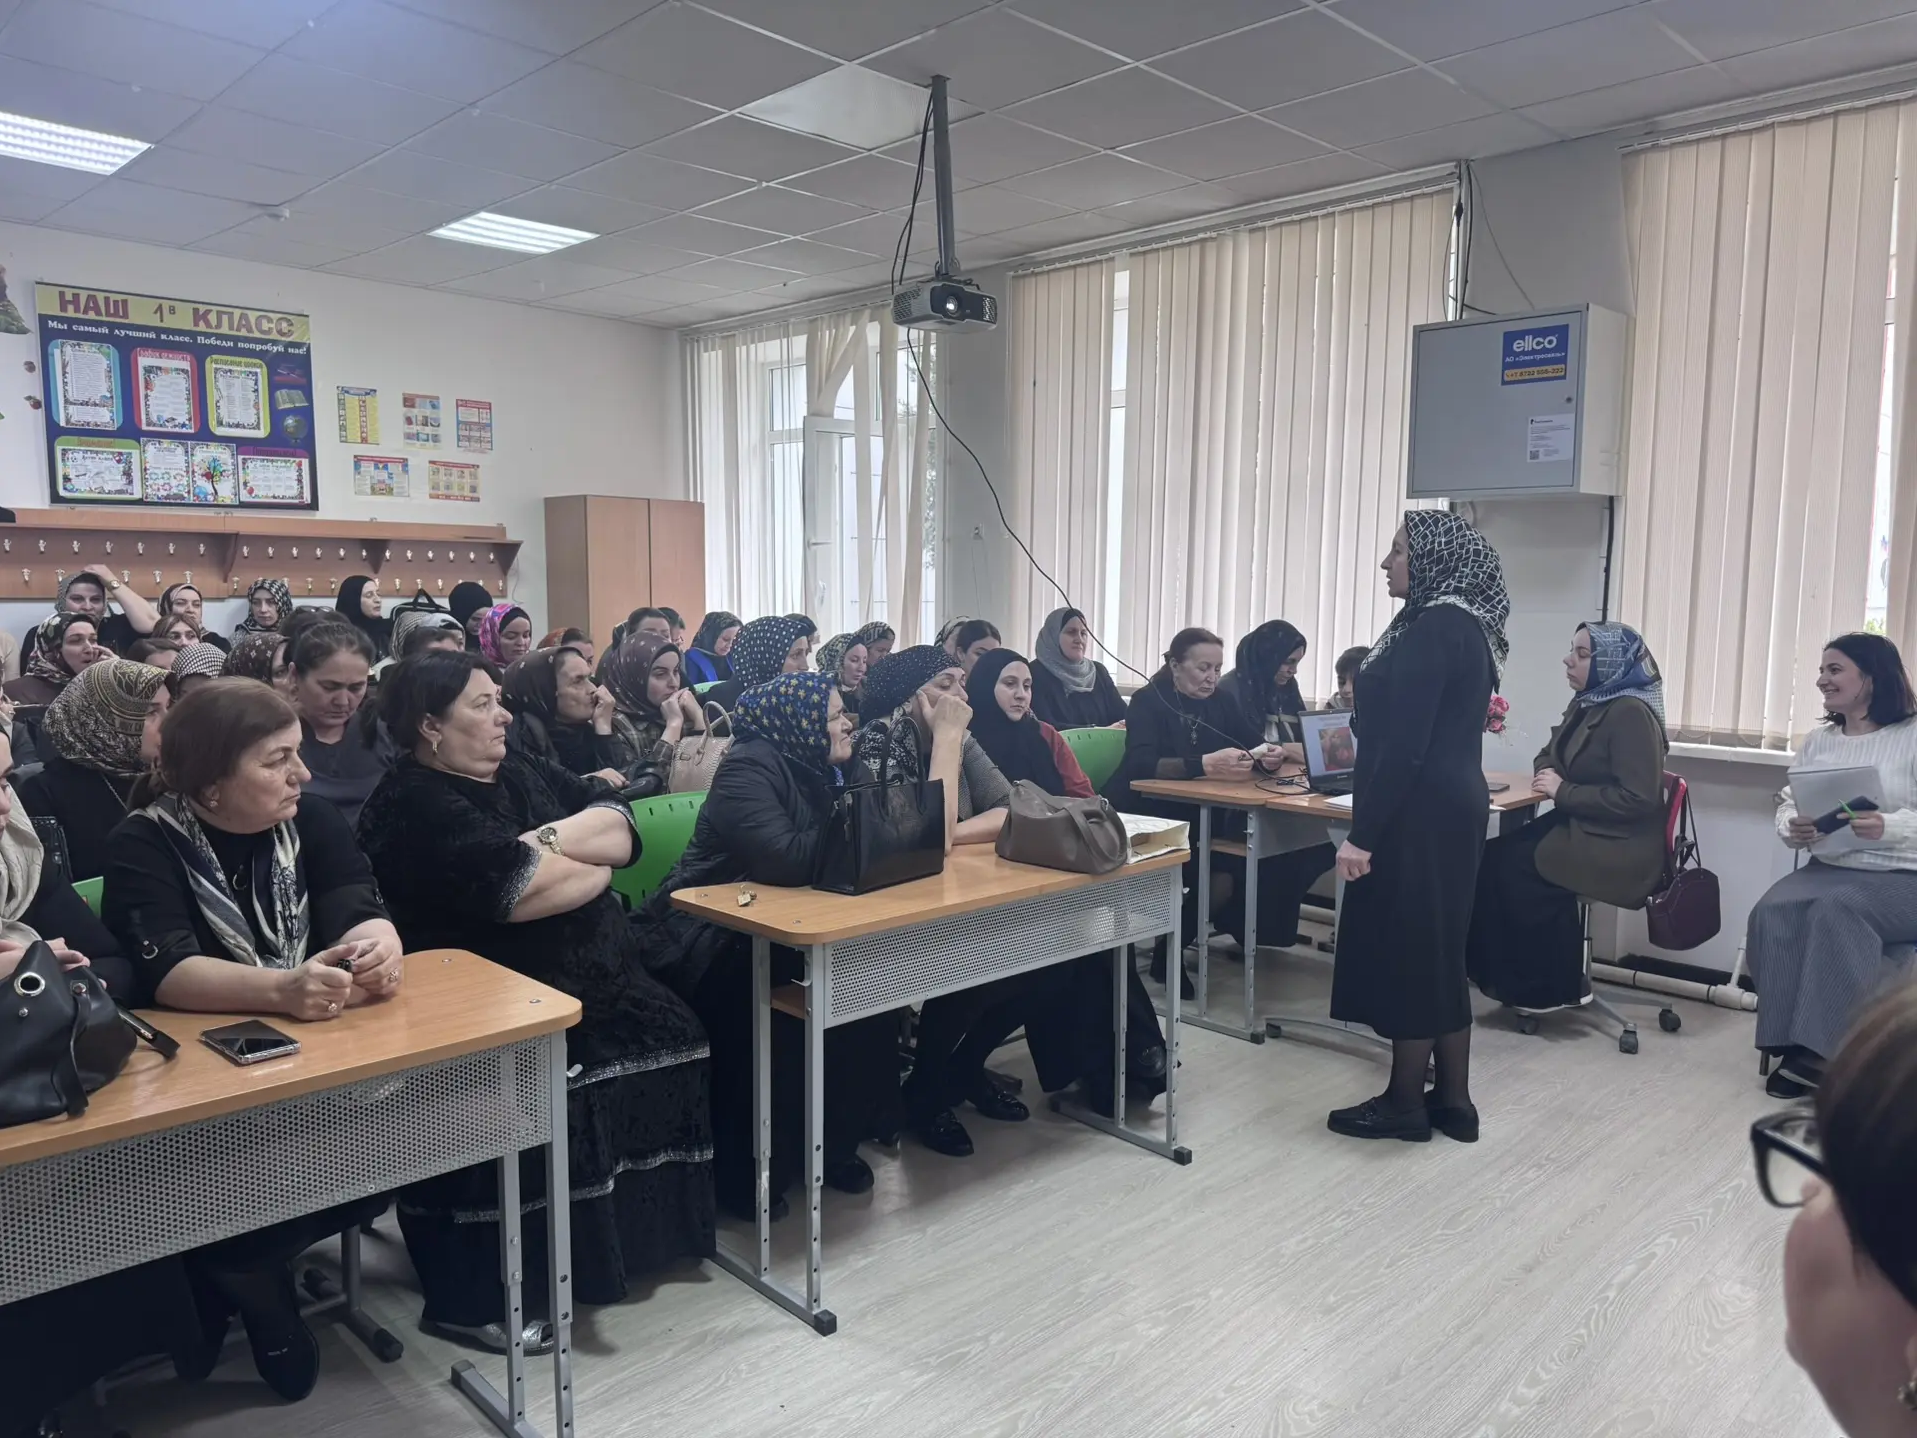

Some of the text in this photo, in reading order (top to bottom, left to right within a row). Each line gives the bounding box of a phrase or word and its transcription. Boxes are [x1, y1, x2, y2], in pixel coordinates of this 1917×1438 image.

[58, 290, 130, 320] НАШ
[192, 307, 295, 338] КЛАСС
[47, 320, 307, 355] Мы самый лучший класс. Победи попробуй нас!
[1513, 335, 1557, 351] ellco
